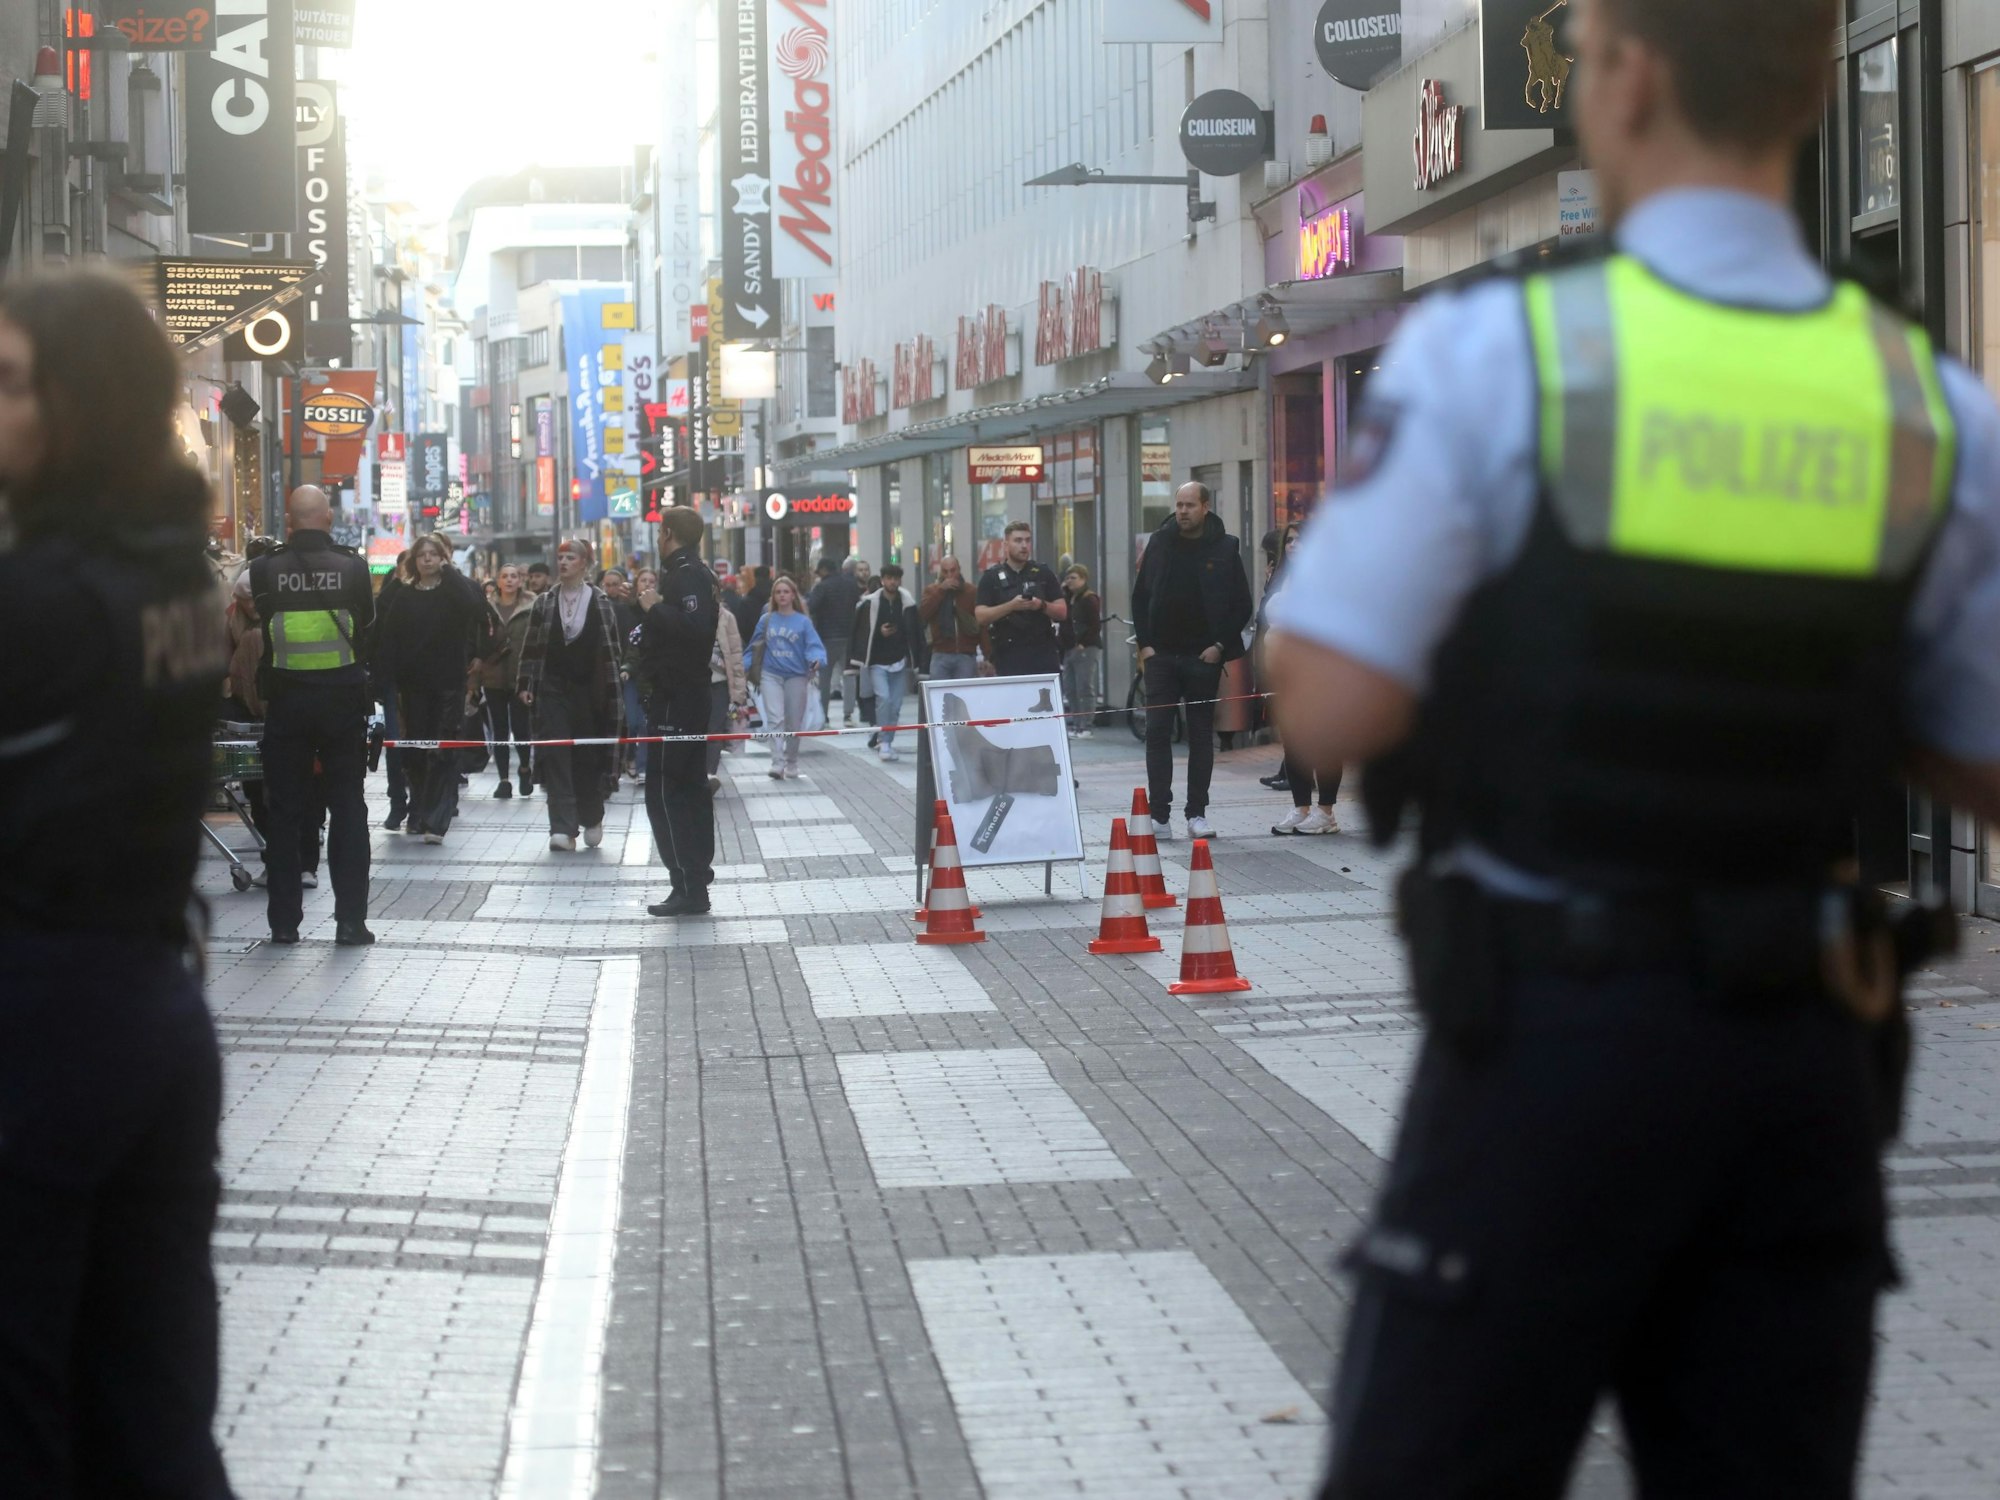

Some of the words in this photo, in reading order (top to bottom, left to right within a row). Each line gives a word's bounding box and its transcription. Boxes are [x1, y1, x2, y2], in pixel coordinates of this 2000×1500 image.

[117, 7, 210, 44] size?
[210, 0, 269, 136] CA
[1188, 118, 1256, 136] COLLOSEUM
[1560, 210, 1580, 221] Free
[1561, 224, 1574, 236] für
[1575, 222, 1595, 234] alle!
[743, 217, 762, 295] SANDY
[166, 267, 307, 275] GESCHENKARTIKEL
[166, 282, 273, 291] ANTIQUITÄTEN
[166, 314, 227, 322] MÜNZEN
[303, 406, 367, 423] FOSSIL
[1637, 405, 1870, 508] POLIZEI
[975, 465, 1022, 478] EINGANG
[791, 493, 850, 513] vodafo
[277, 571, 342, 592] POLIZEI
[975, 799, 1008, 847] Tamaris
